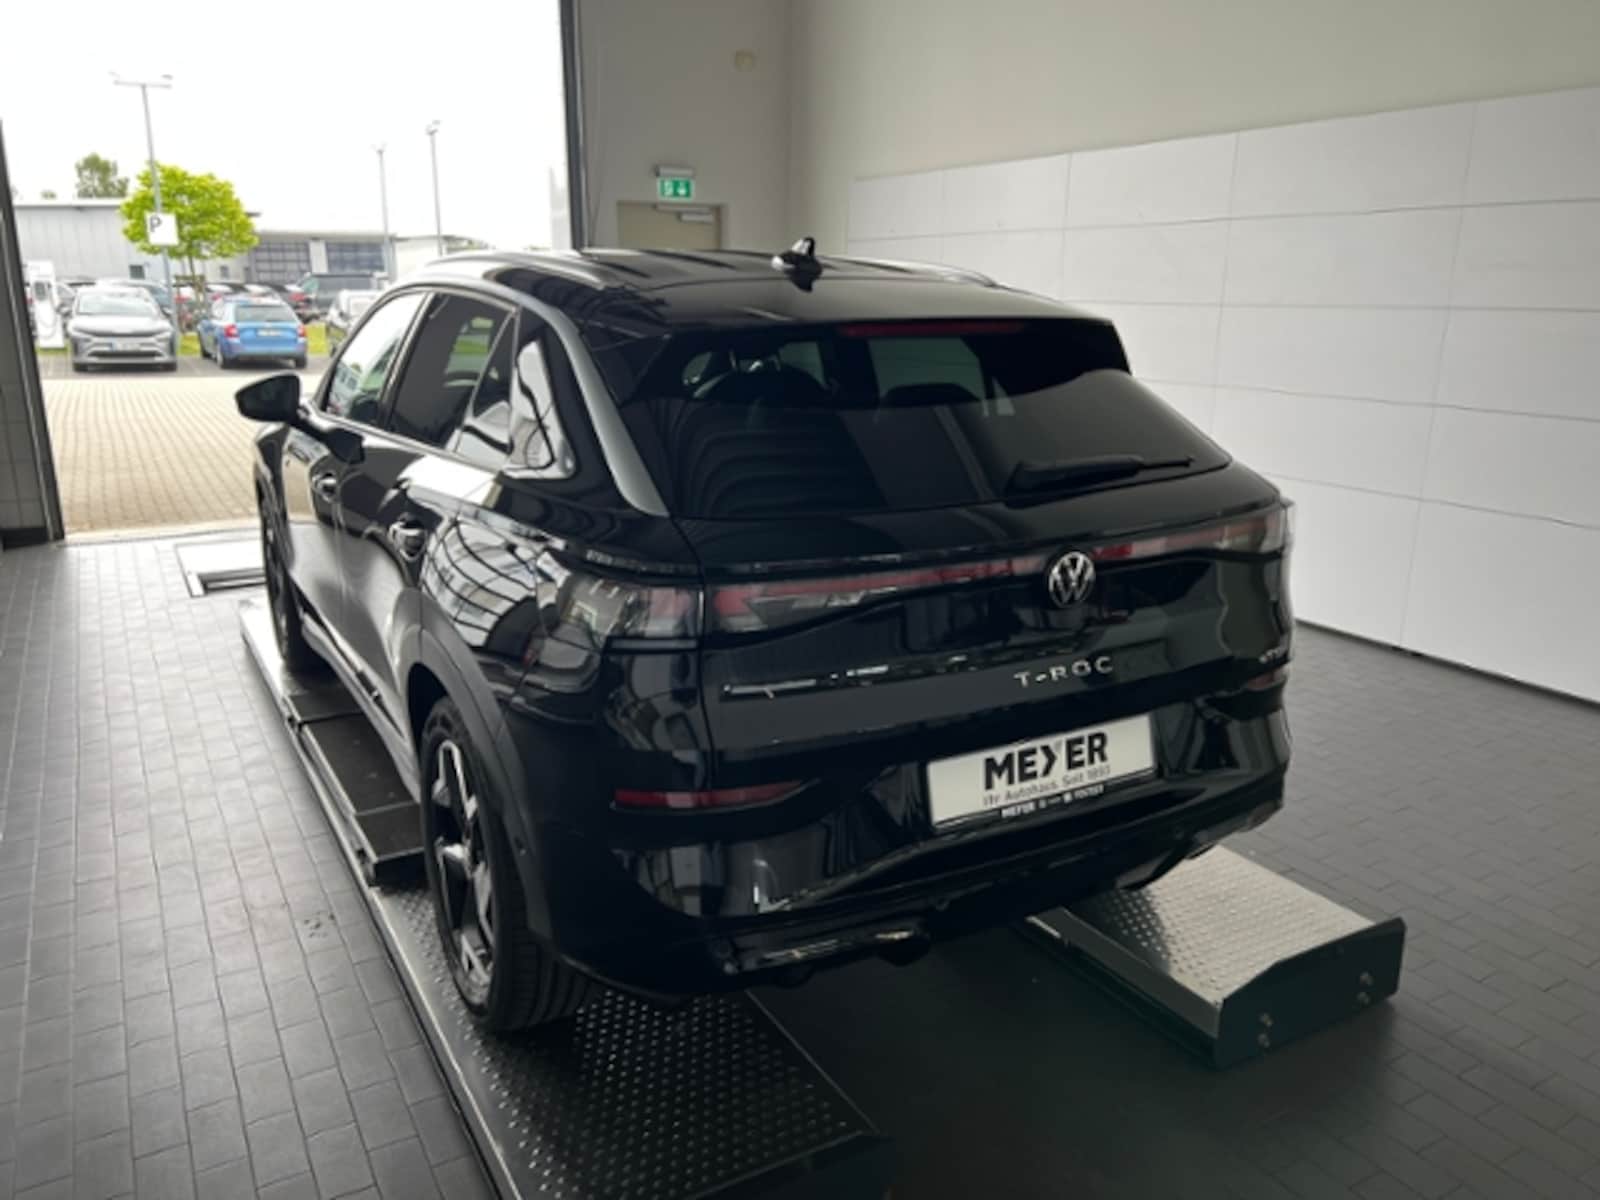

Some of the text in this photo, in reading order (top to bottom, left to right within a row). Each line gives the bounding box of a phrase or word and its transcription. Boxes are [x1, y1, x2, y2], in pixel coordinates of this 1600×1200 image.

[150, 215, 163, 233] P
[1013, 656, 1113, 688] T-ROC
[984, 732, 1108, 790] MEYER
